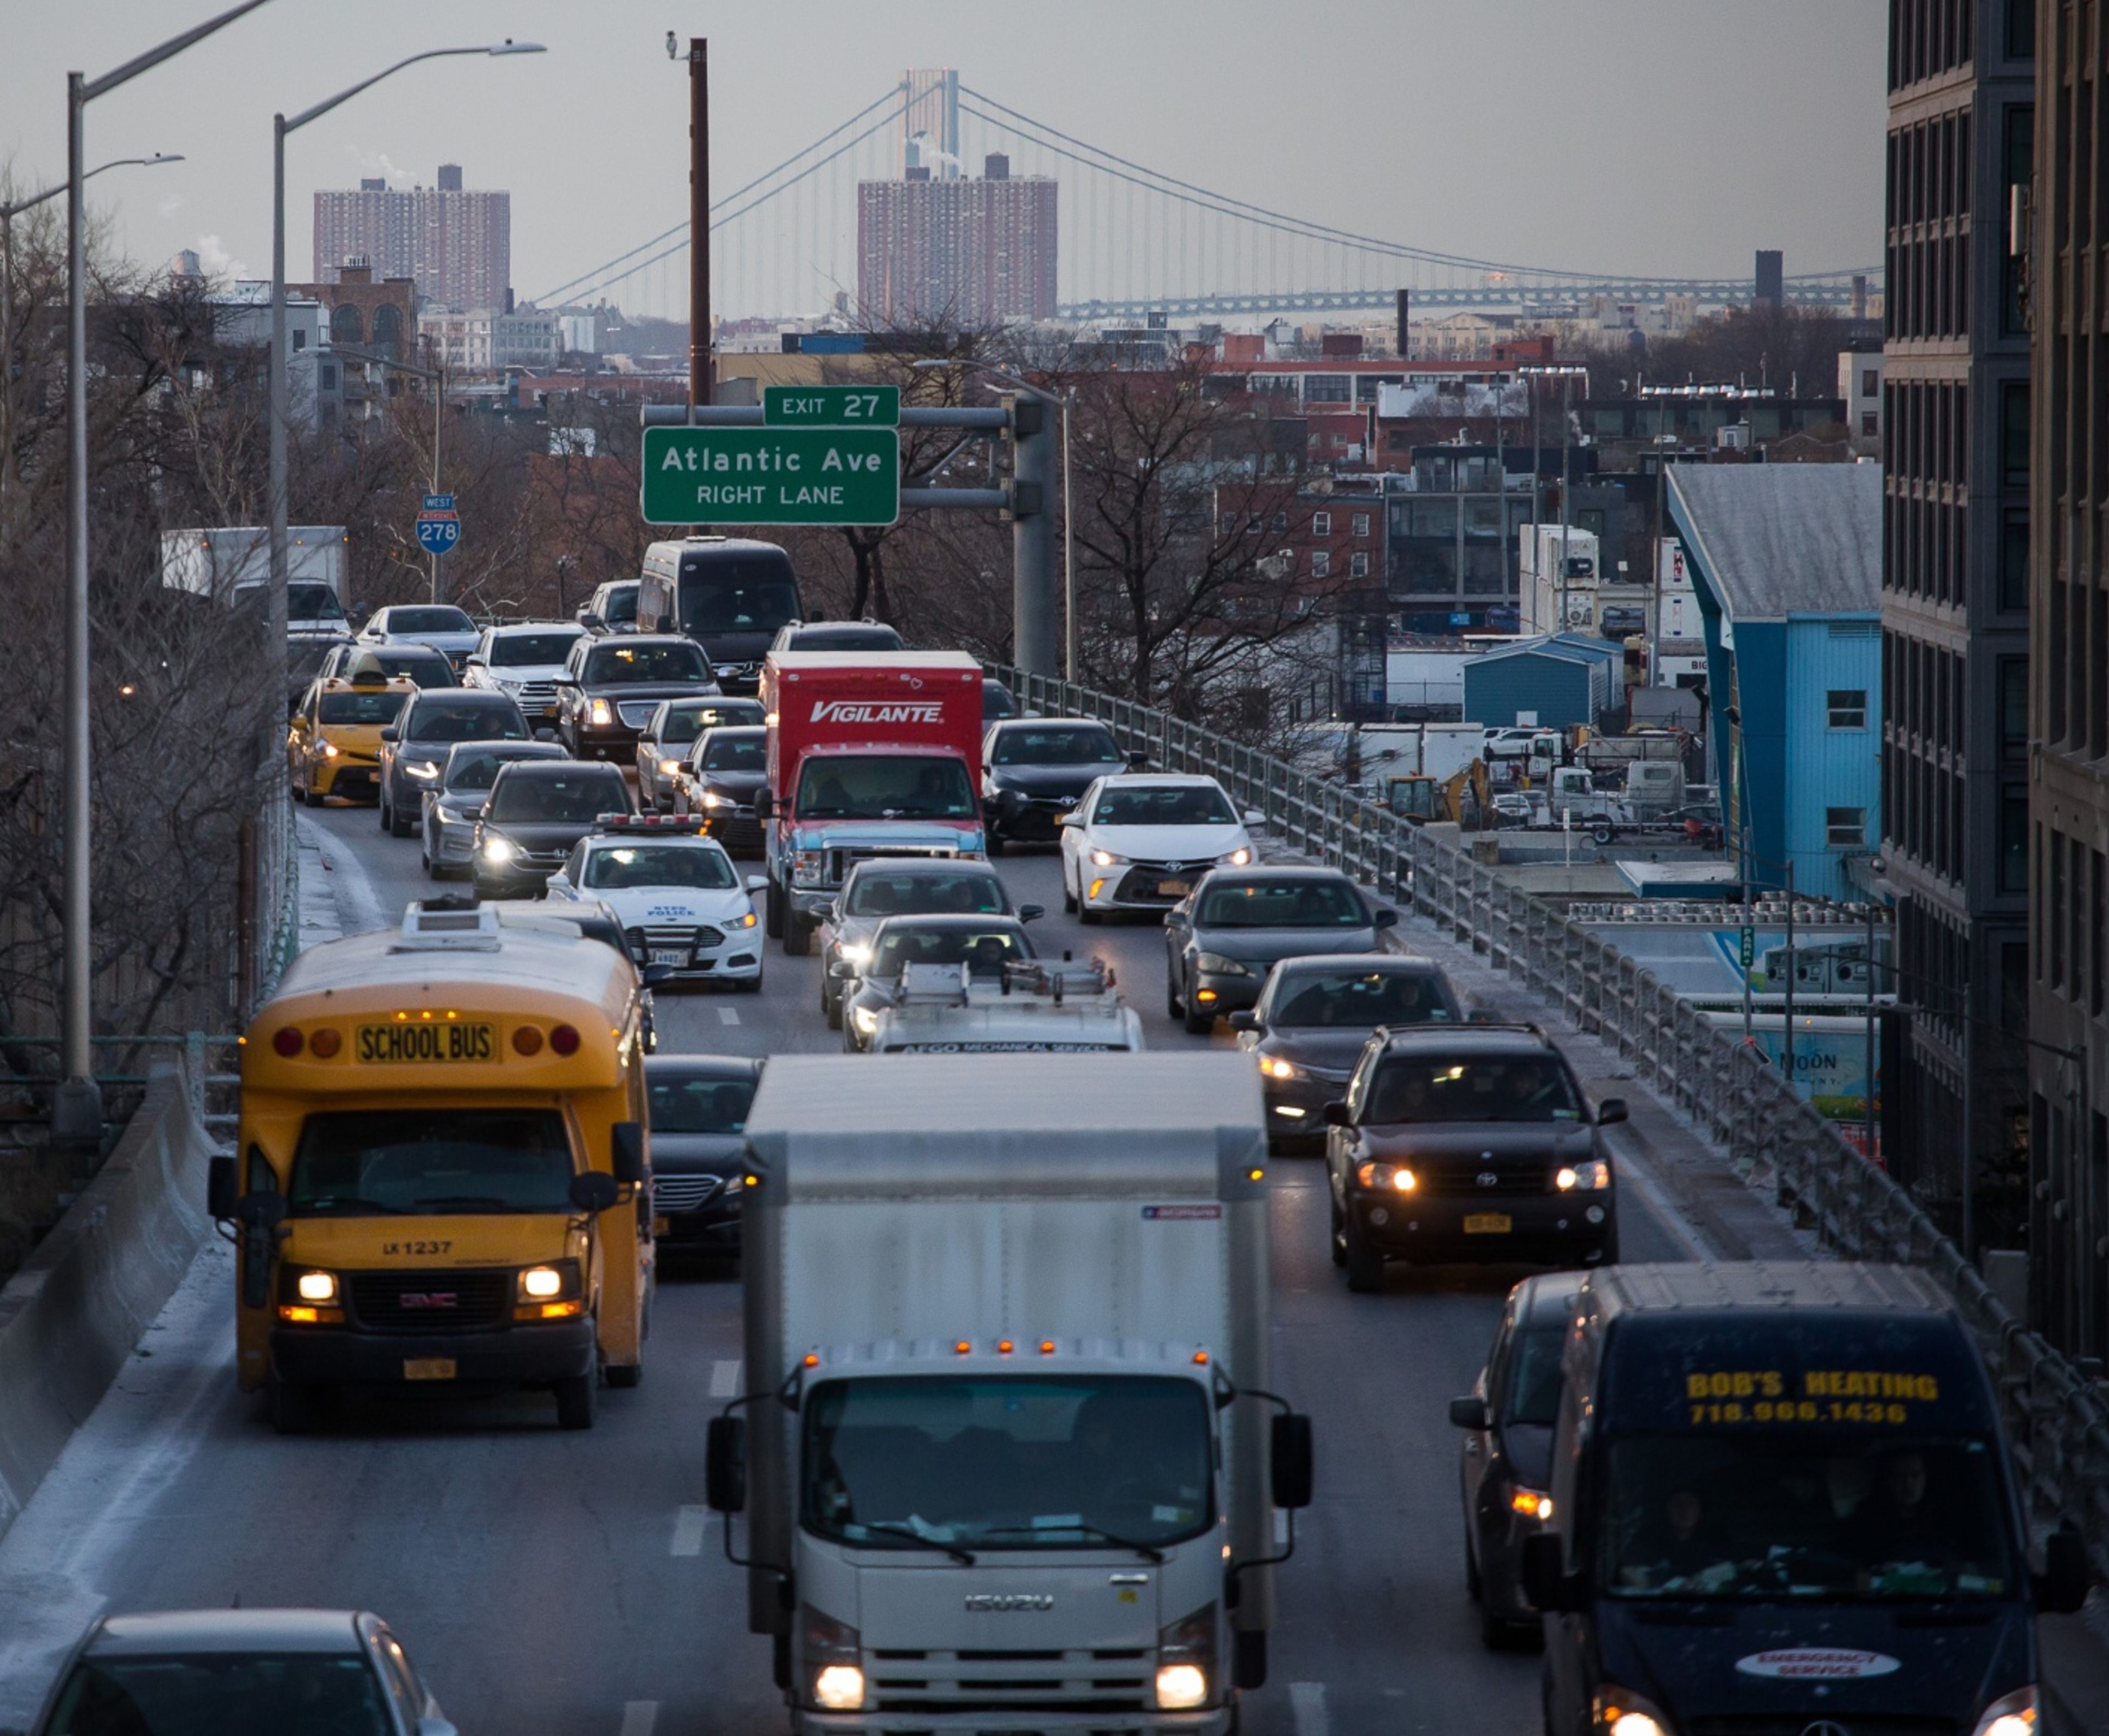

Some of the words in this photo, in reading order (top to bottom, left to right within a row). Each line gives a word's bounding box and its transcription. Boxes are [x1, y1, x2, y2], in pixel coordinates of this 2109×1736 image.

[782, 398, 825, 414] EXIT
[843, 395, 880, 417] 27
[661, 446, 801, 471] Atlantic
[821, 448, 882, 471] Ave
[425, 498, 450, 507] WEST
[697, 486, 766, 504] RIGHT
[780, 486, 844, 504] LANE
[421, 523, 456, 541] 278
[810, 701, 943, 723] VIGILANTE
[1743, 928, 1752, 957] PARK
[361, 1026, 444, 1059] SCHOOL
[450, 1026, 490, 1058] BUS
[403, 1241, 453, 1255] 1237
[399, 1292, 457, 1307] GMC
[1687, 1371, 1783, 1398] BOB'S
[1805, 1371, 1938, 1400] HEATING
[965, 1594, 1054, 1611] ISUZU
[1758, 1653, 1878, 1663] EMERGENCY
[1779, 1665, 1860, 1676] SERVICE
